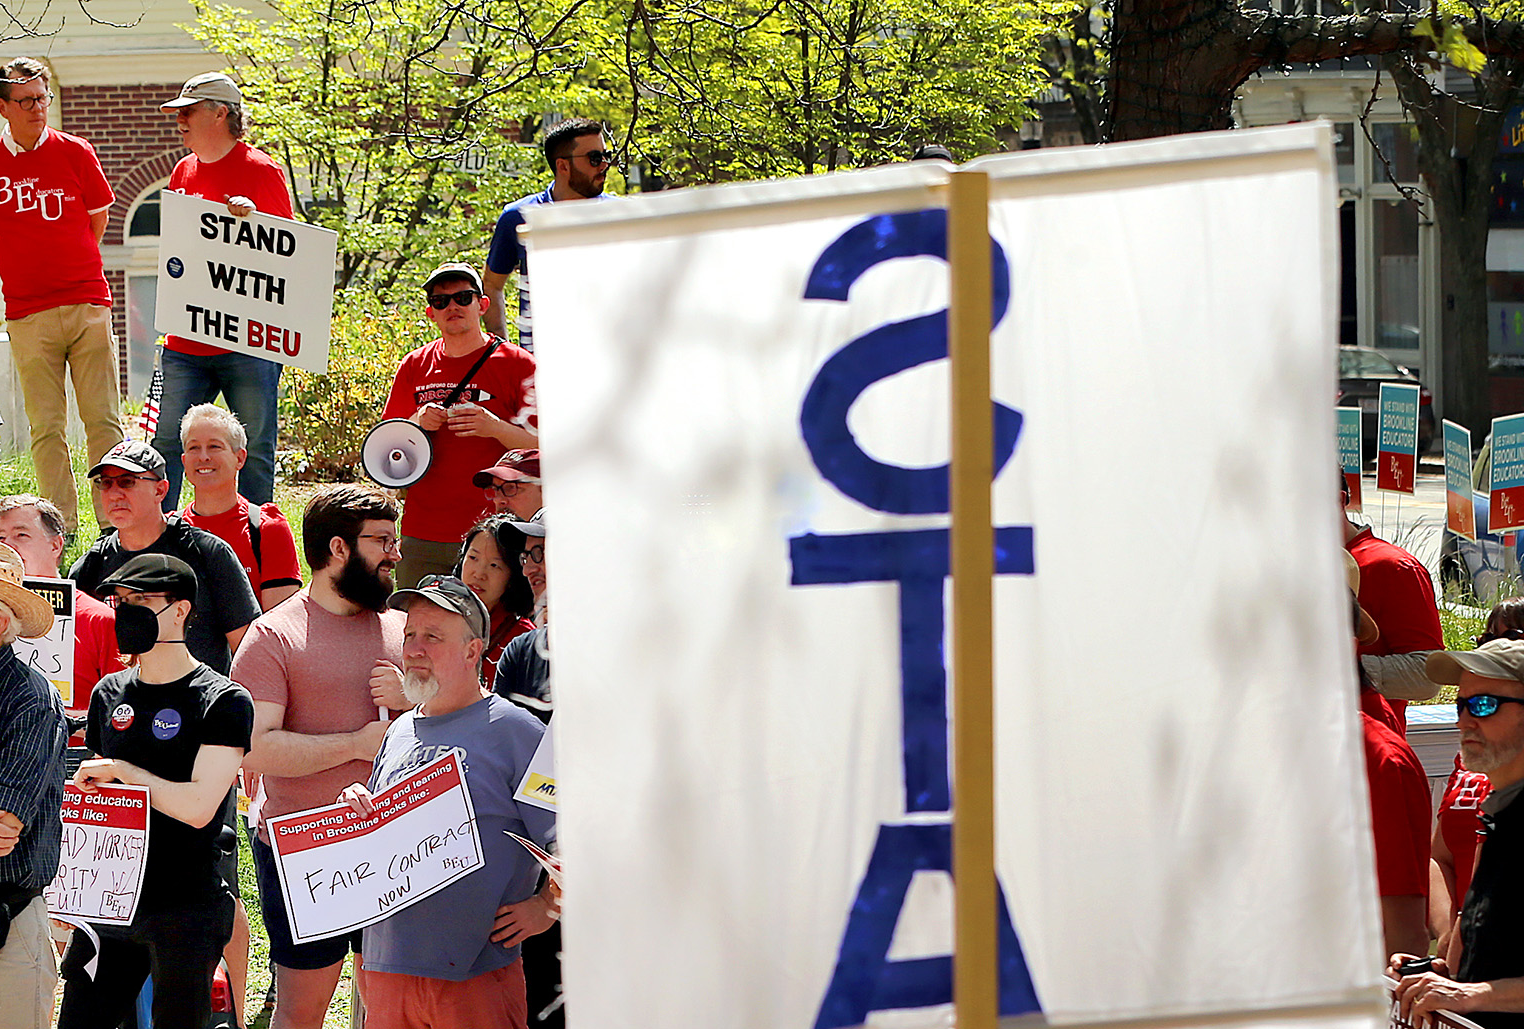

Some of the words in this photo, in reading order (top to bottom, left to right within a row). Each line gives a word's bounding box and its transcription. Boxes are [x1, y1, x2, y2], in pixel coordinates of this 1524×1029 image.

[200, 212, 296, 257] STAND
[207, 260, 286, 305] WITH
[186, 304, 239, 343] THE
[247, 318, 301, 357] BEU
[1392, 401, 1405, 413] STAND
[1383, 414, 1415, 431] BROOKLINE
[1383, 430, 1414, 448] EDUCATORS
[84, 793, 143, 809] educators
[279, 814, 343, 836] Supporting
[345, 796, 391, 819] teing
[392, 784, 411, 800] and
[412, 763, 453, 789] learning
[326, 817, 379, 838] Brookline
[380, 800, 407, 819] looks
[408, 788, 430, 804] like:
[82, 808, 108, 822] like:
[442, 853, 470, 871] BEU
[304, 862, 376, 904] FAIR
[377, 875, 411, 912] NOW
[105, 895, 129, 918] BEU
